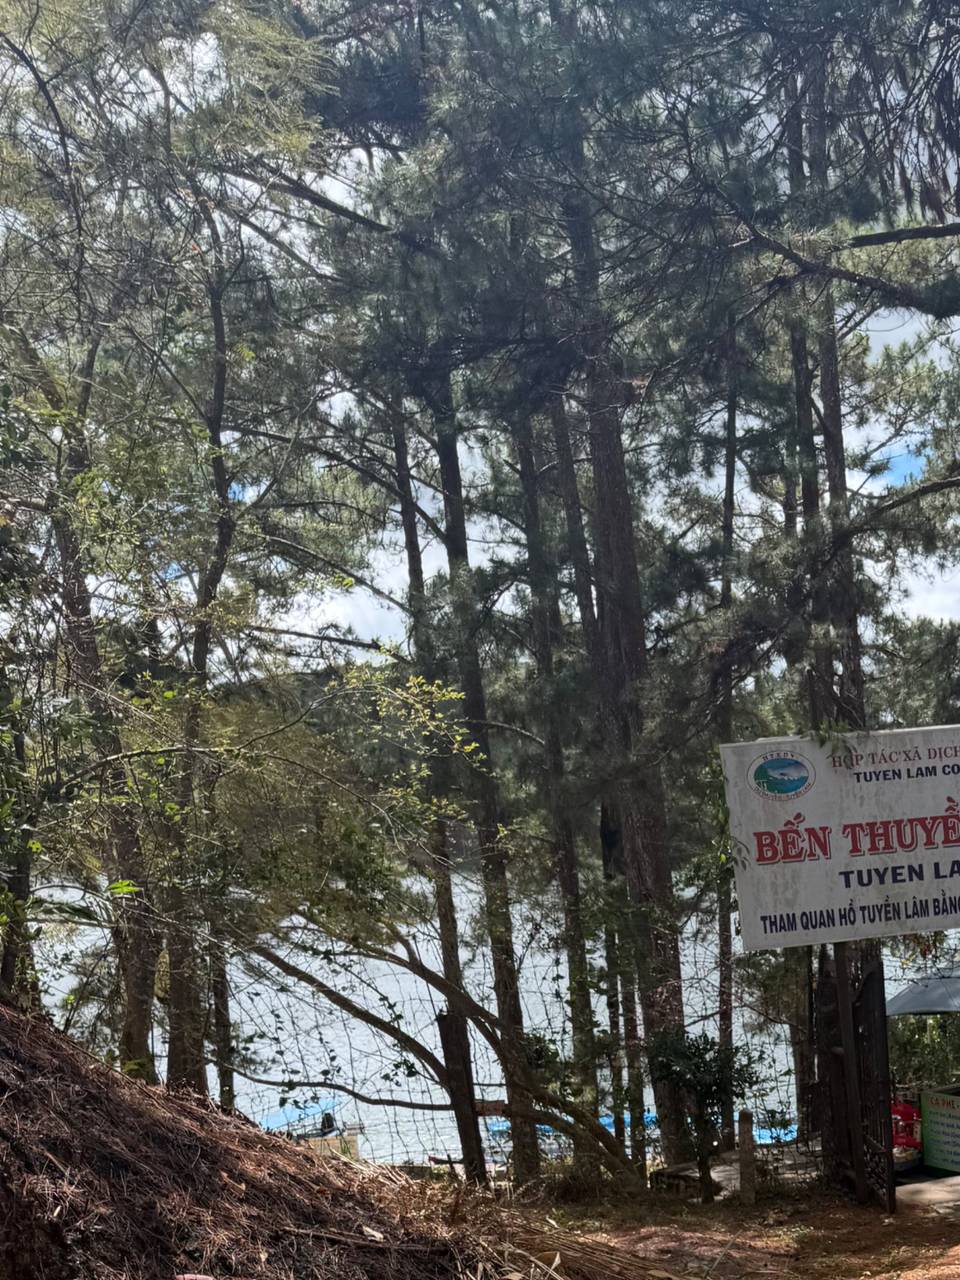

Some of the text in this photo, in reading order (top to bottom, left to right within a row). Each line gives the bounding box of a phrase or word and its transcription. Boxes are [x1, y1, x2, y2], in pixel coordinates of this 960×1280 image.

[853, 768, 902, 783] TUYEN
[906, 766, 937, 779] LAM
[752, 812, 831, 865] BẾN
[839, 864, 924, 889] TUYEN
[760, 912, 797, 934] THAM
[801, 908, 836, 931] QUAN
[839, 898, 856, 926] HỒ
[904, 896, 930, 920] LÂM
